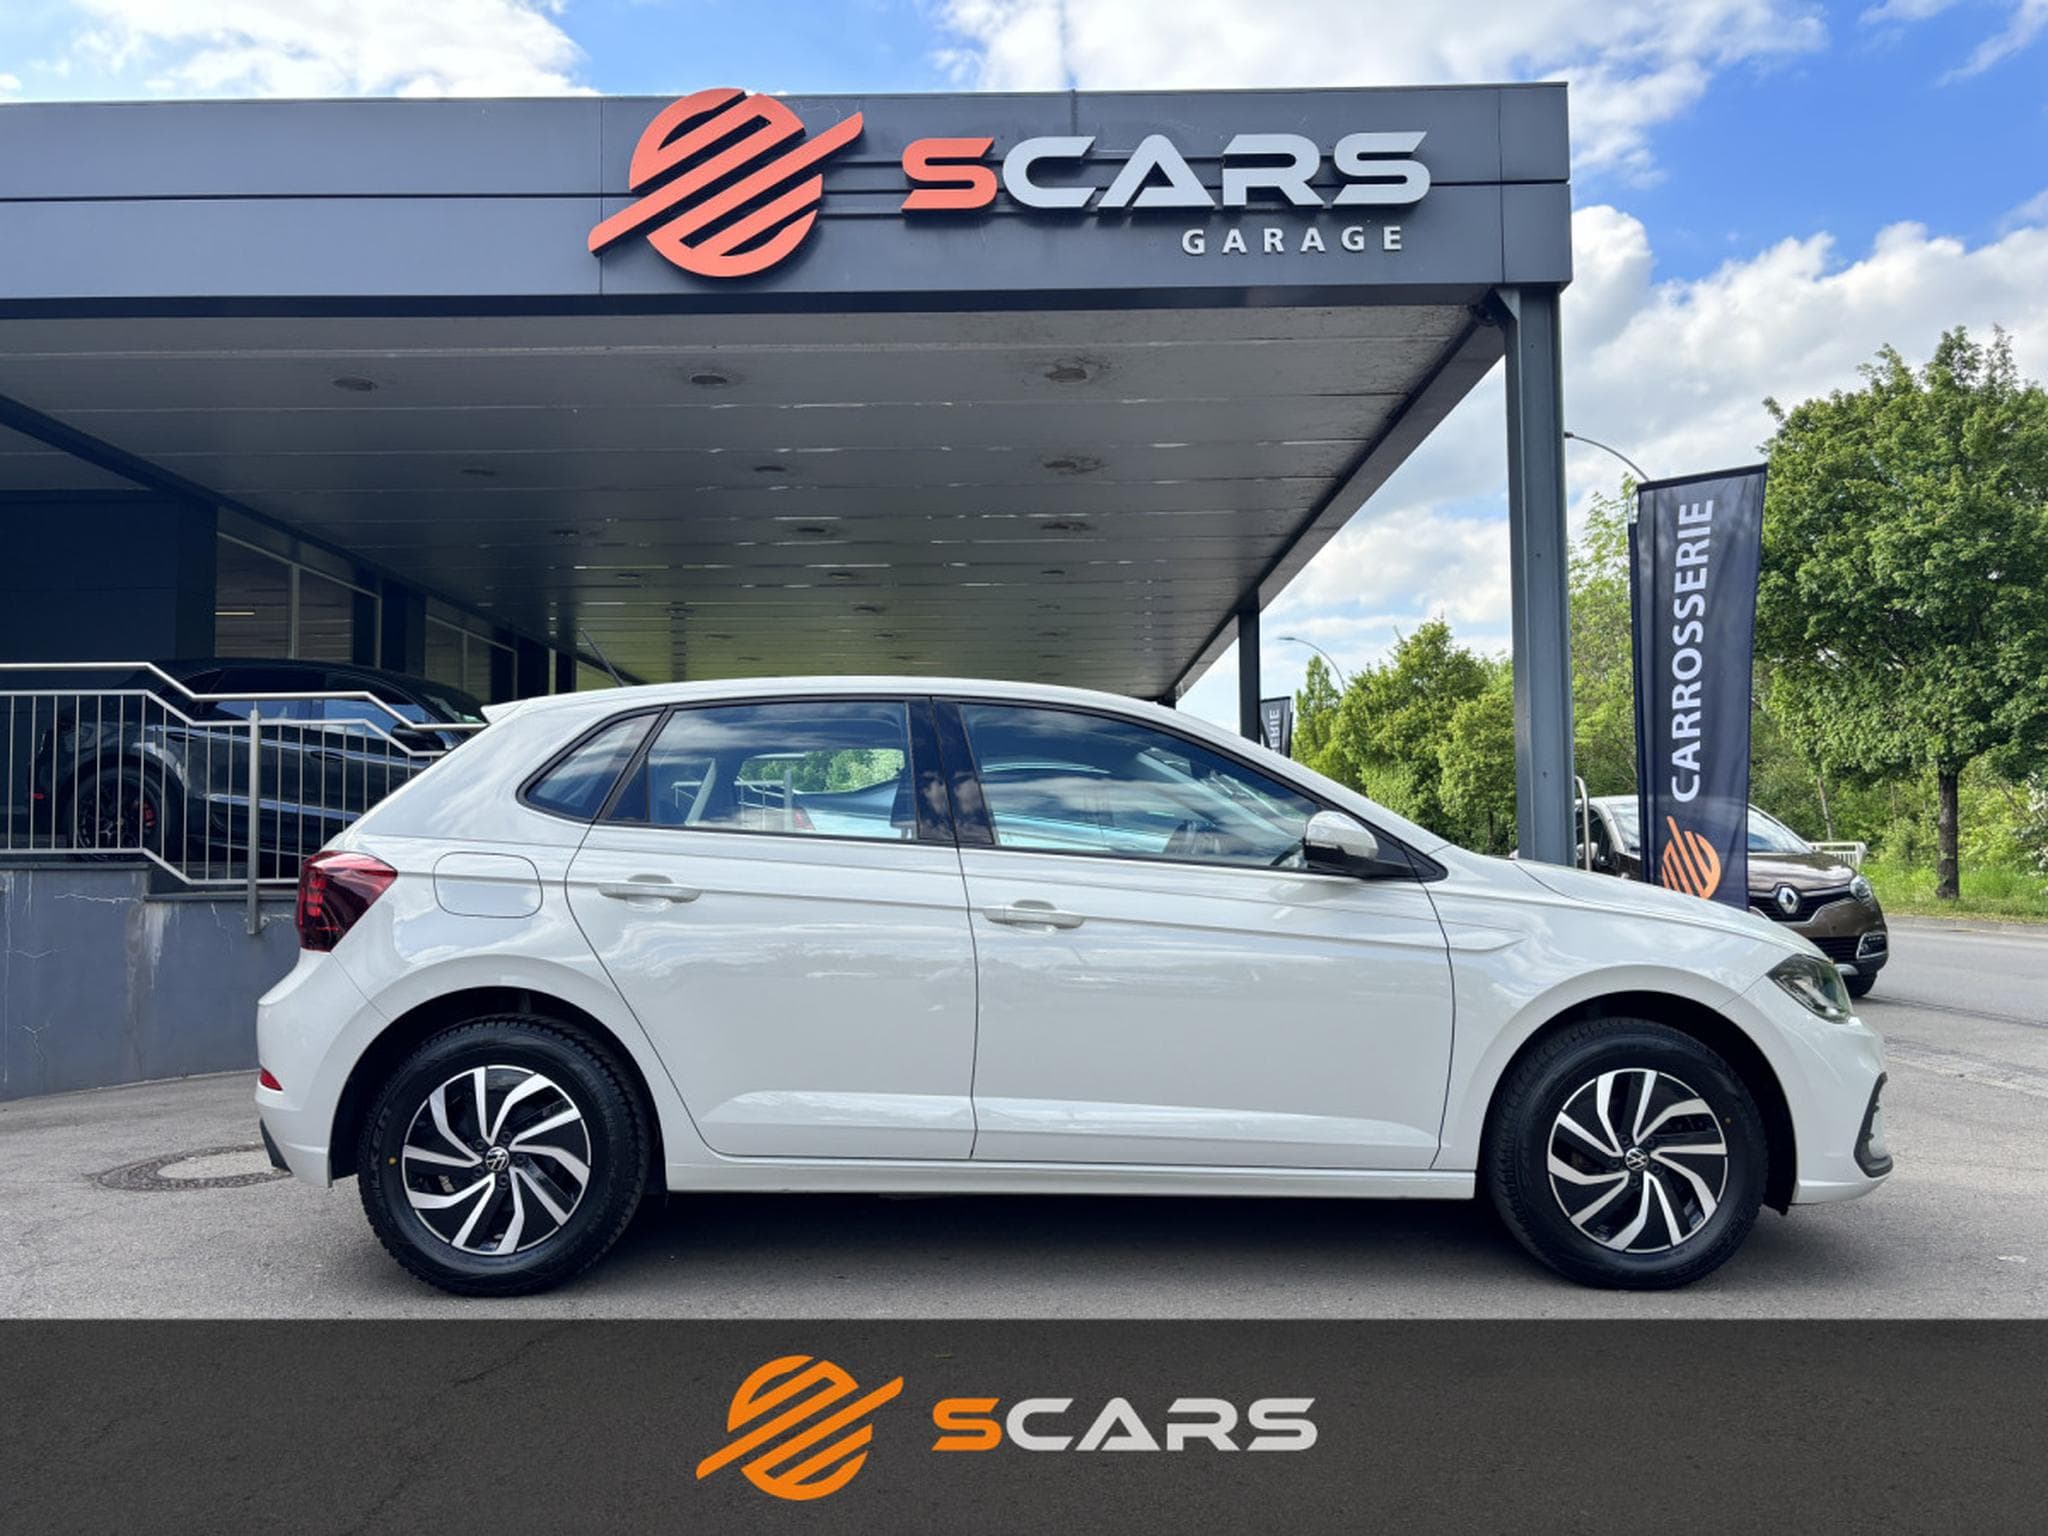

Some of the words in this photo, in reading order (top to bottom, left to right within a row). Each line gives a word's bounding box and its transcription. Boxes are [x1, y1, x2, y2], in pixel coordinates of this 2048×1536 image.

[901, 131, 1431, 210] SCARS
[1181, 226, 1403, 255] GARAGE
[1671, 499, 1715, 803] CARROSSERIE
